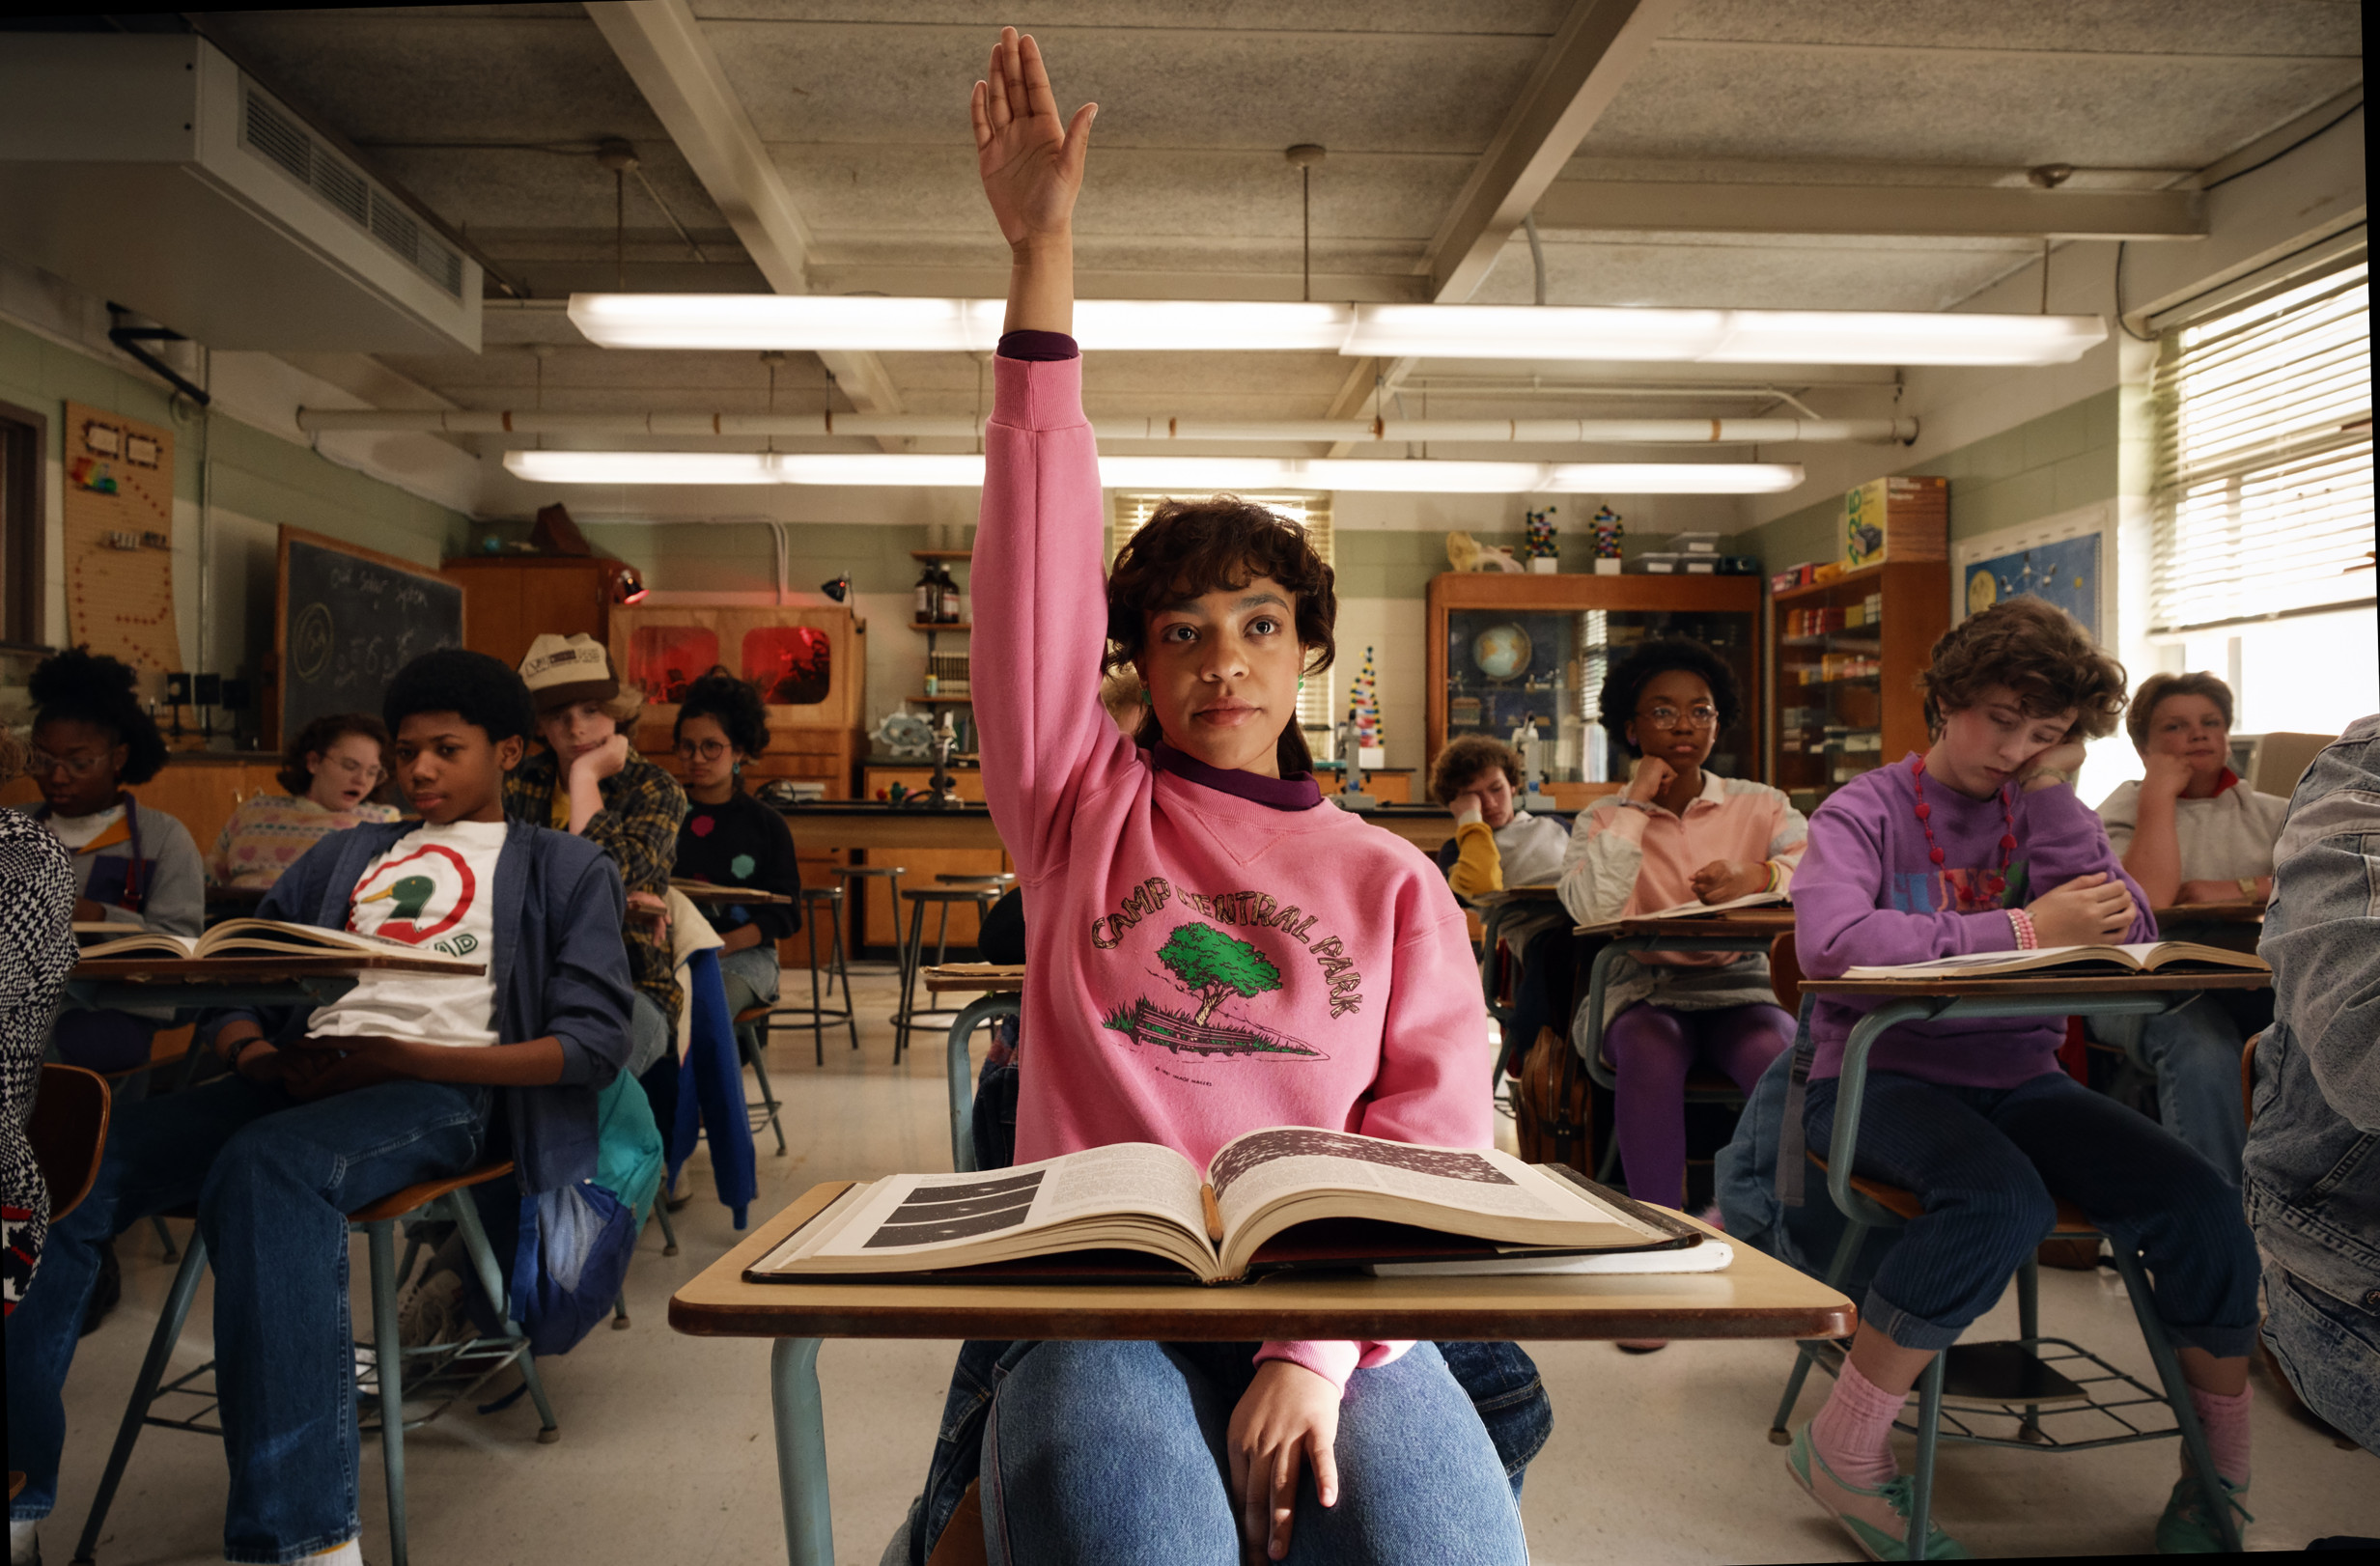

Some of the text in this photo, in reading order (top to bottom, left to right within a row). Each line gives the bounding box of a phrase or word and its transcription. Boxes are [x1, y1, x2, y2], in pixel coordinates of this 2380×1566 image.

[434, 933, 478, 957] AD
[1091, 877, 1362, 1020] CAMP CENTRAL PARK
